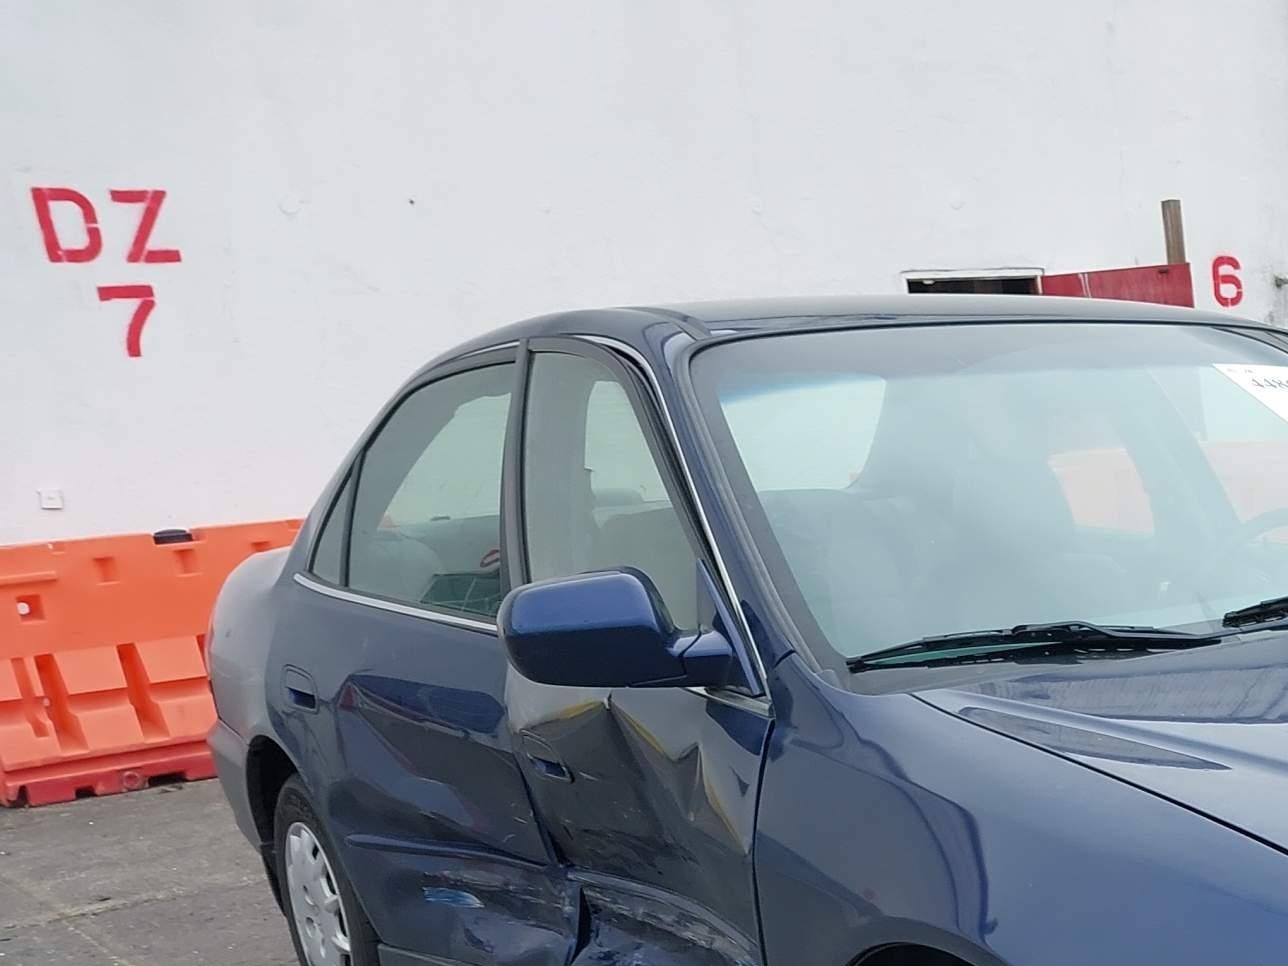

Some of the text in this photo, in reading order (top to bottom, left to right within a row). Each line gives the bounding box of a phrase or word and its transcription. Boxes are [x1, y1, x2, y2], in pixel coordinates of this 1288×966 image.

[30, 185, 184, 266] DZ
[1210, 254, 1245, 309] 6
[96, 283, 158, 360] 7
